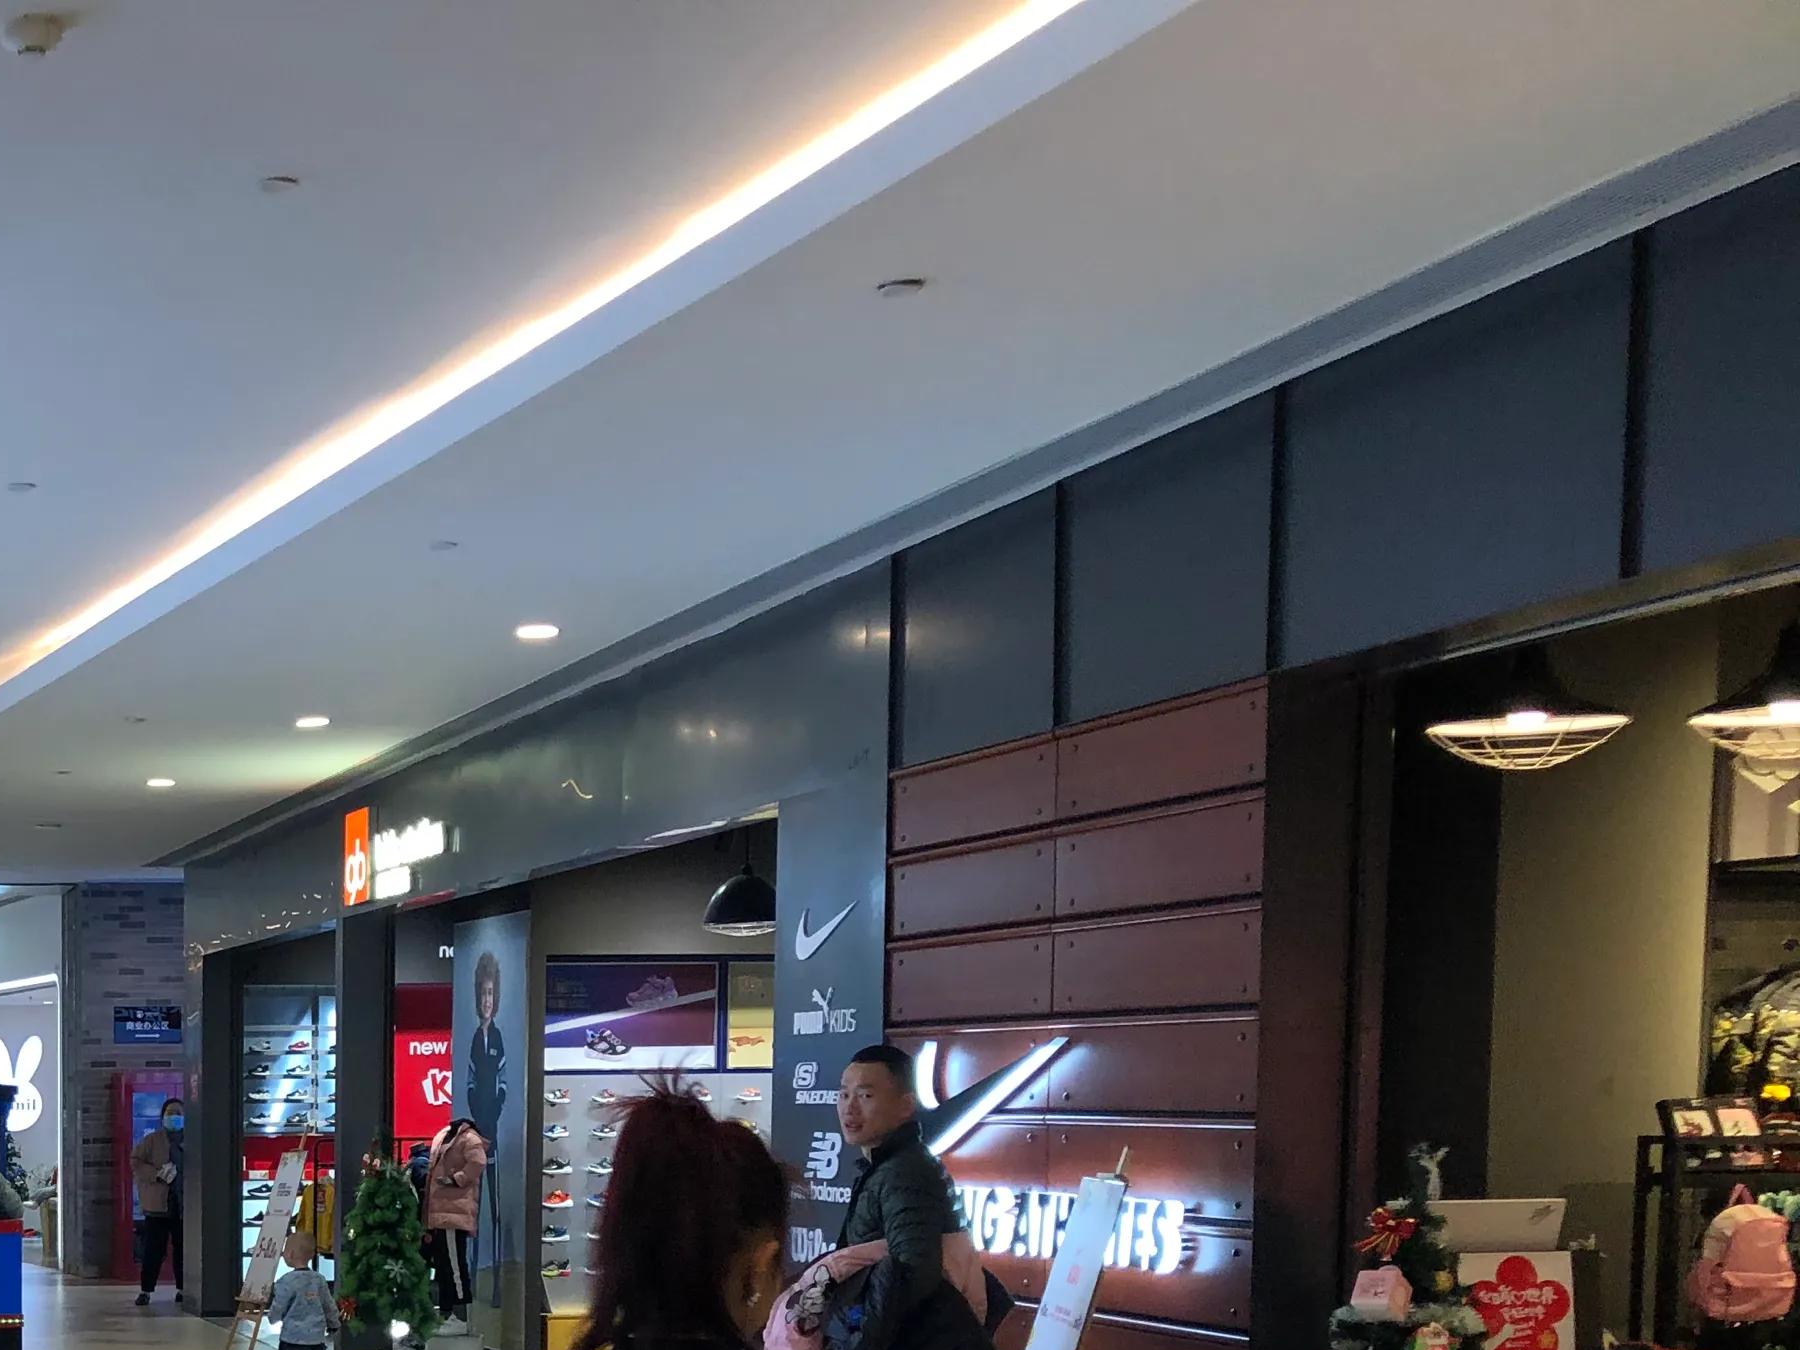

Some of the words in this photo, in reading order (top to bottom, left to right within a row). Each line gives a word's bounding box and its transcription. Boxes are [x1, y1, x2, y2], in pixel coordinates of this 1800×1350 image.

[829, 1008, 857, 1033] KIDS
[409, 1041, 448, 1056] new
[795, 1090, 839, 1105] SKECHE
[810, 1181, 852, 1204] balance
